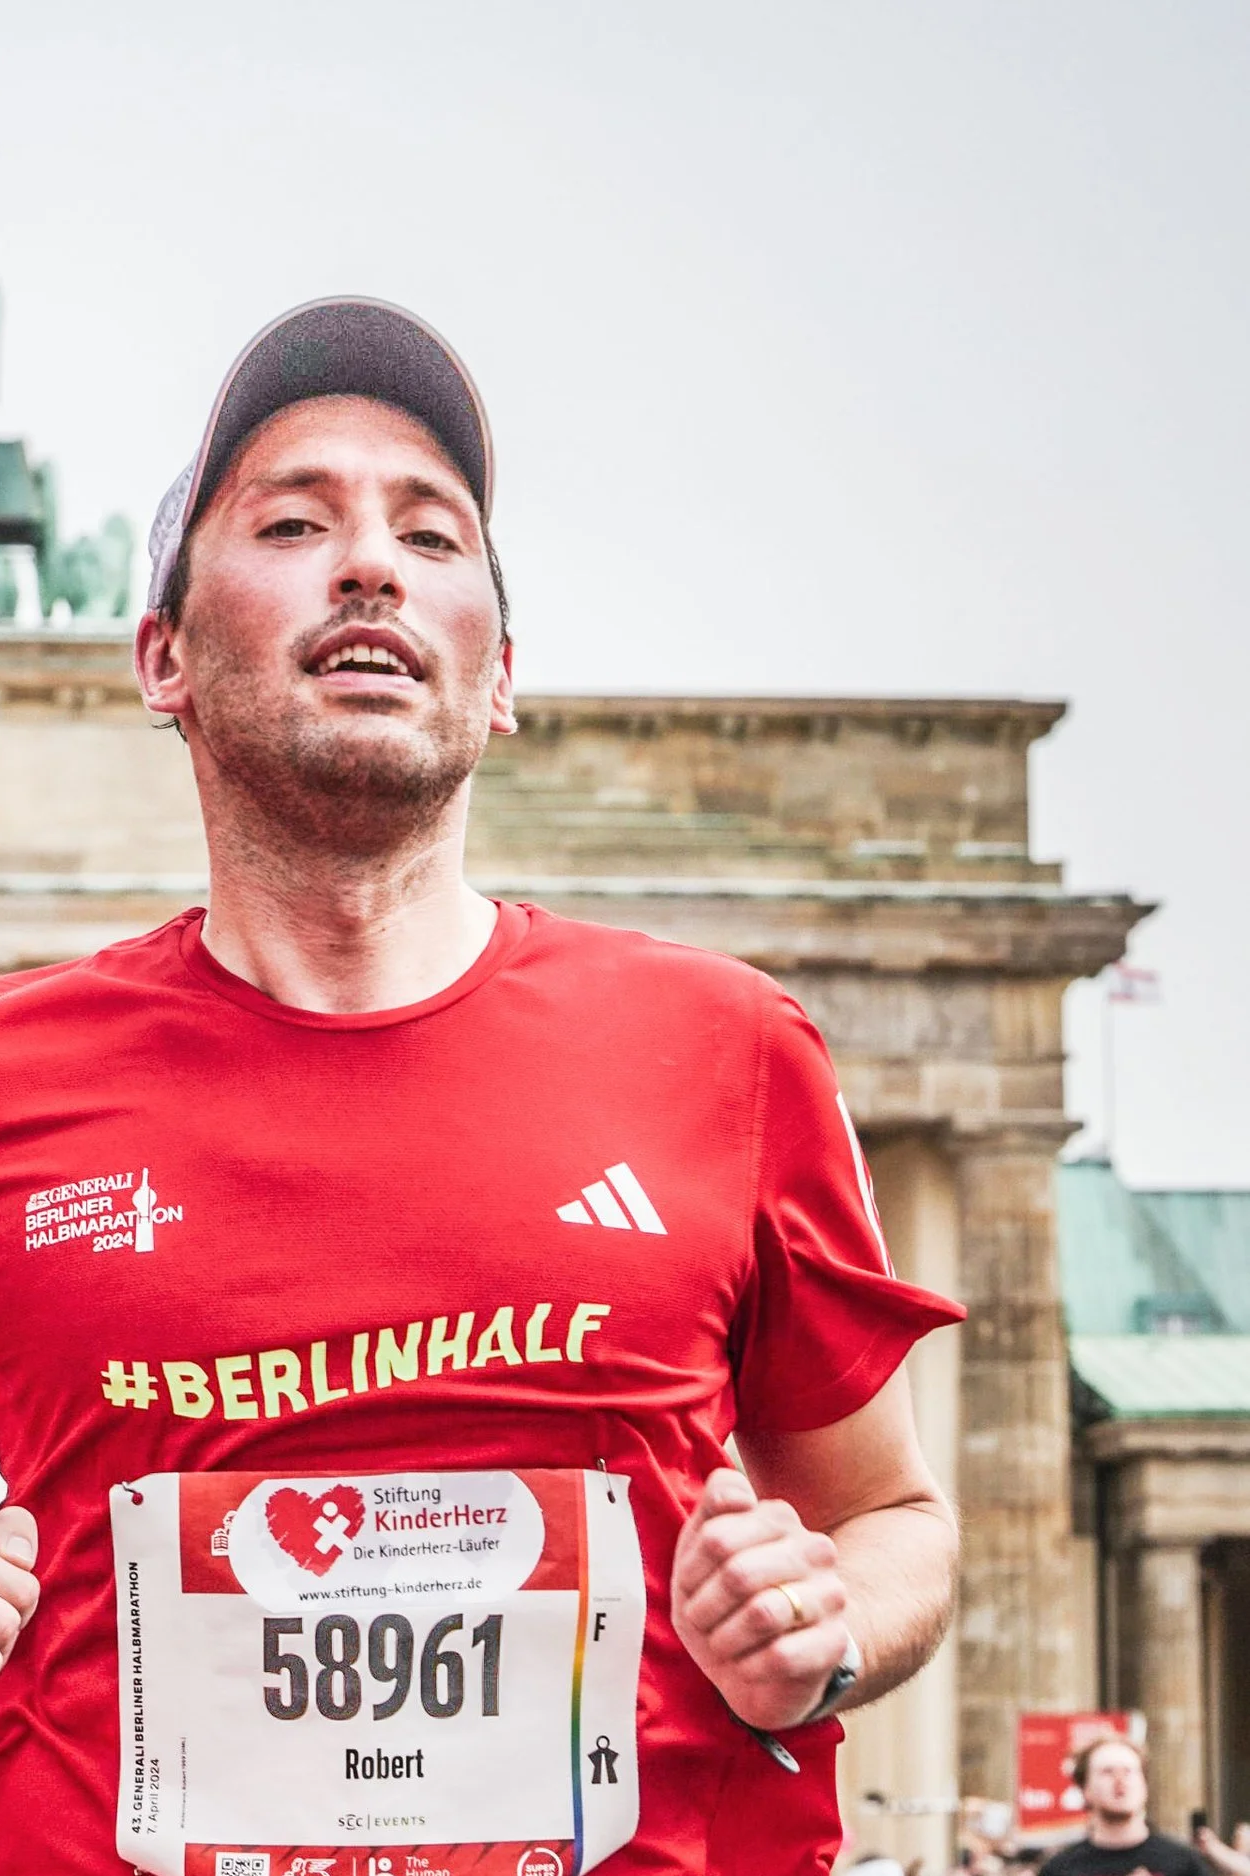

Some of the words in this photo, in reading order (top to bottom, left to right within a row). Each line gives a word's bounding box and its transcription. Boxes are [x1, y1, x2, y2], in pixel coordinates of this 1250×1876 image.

[48, 1172, 134, 1204] GENERALI
[25, 1196, 113, 1232] BERLINER
[92, 1231, 135, 1252] 2024
[100, 1302, 611, 1422] #BERLINHALF
[373, 1487, 441, 1505] Stiftung
[374, 1504, 507, 1532] KinderHerz
[353, 1545, 375, 1560] Die
[379, 1537, 501, 1558] KinderHerz-Läufer
[298, 1577, 483, 1602] www.stiftung-kinderherz.de
[129, 1562, 142, 1673] HALBMARATHON
[593, 1612, 607, 1642] F
[262, 1612, 505, 1722] 58961
[133, 1678, 144, 1741] BERLINER
[133, 1746, 144, 1810] GENERALI
[150, 1758, 160, 1790] 2024
[345, 1748, 425, 1781] Robert
[148, 1793, 160, 1822] April
[338, 1815, 364, 1829] SCC
[374, 1816, 426, 1827] EVENTS
[132, 1815, 142, 1833] 43.
[405, 1856, 429, 1868] The
[525, 1863, 556, 1873] SUPER
